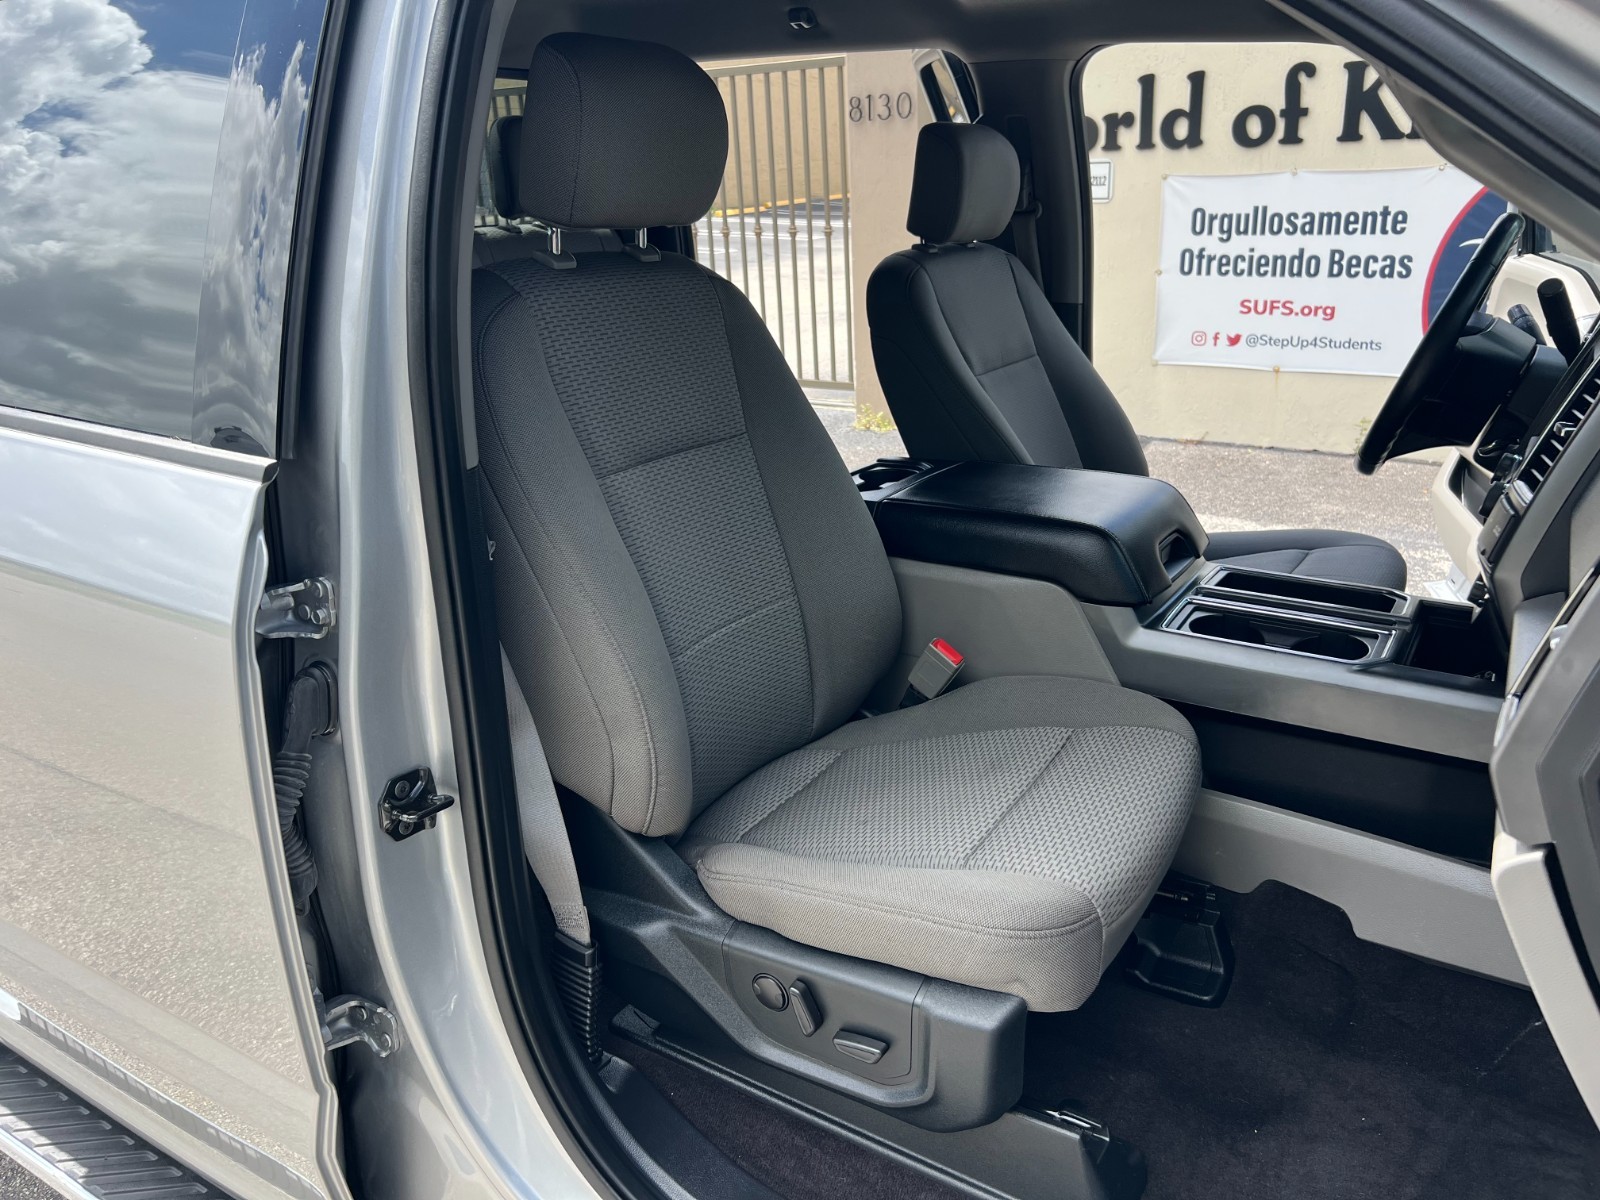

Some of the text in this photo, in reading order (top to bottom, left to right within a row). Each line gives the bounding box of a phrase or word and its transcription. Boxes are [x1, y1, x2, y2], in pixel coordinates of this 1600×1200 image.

[849, 91, 912, 123] 8130
[1231, 61, 1317, 149] of
[1190, 205, 1409, 243] Orgullosamente
[1179, 247, 1414, 279] Ofreciendo Becas
[1239, 299, 1336, 321] SUFS.org
[1245, 333, 1382, 351] @StepUp4Students
